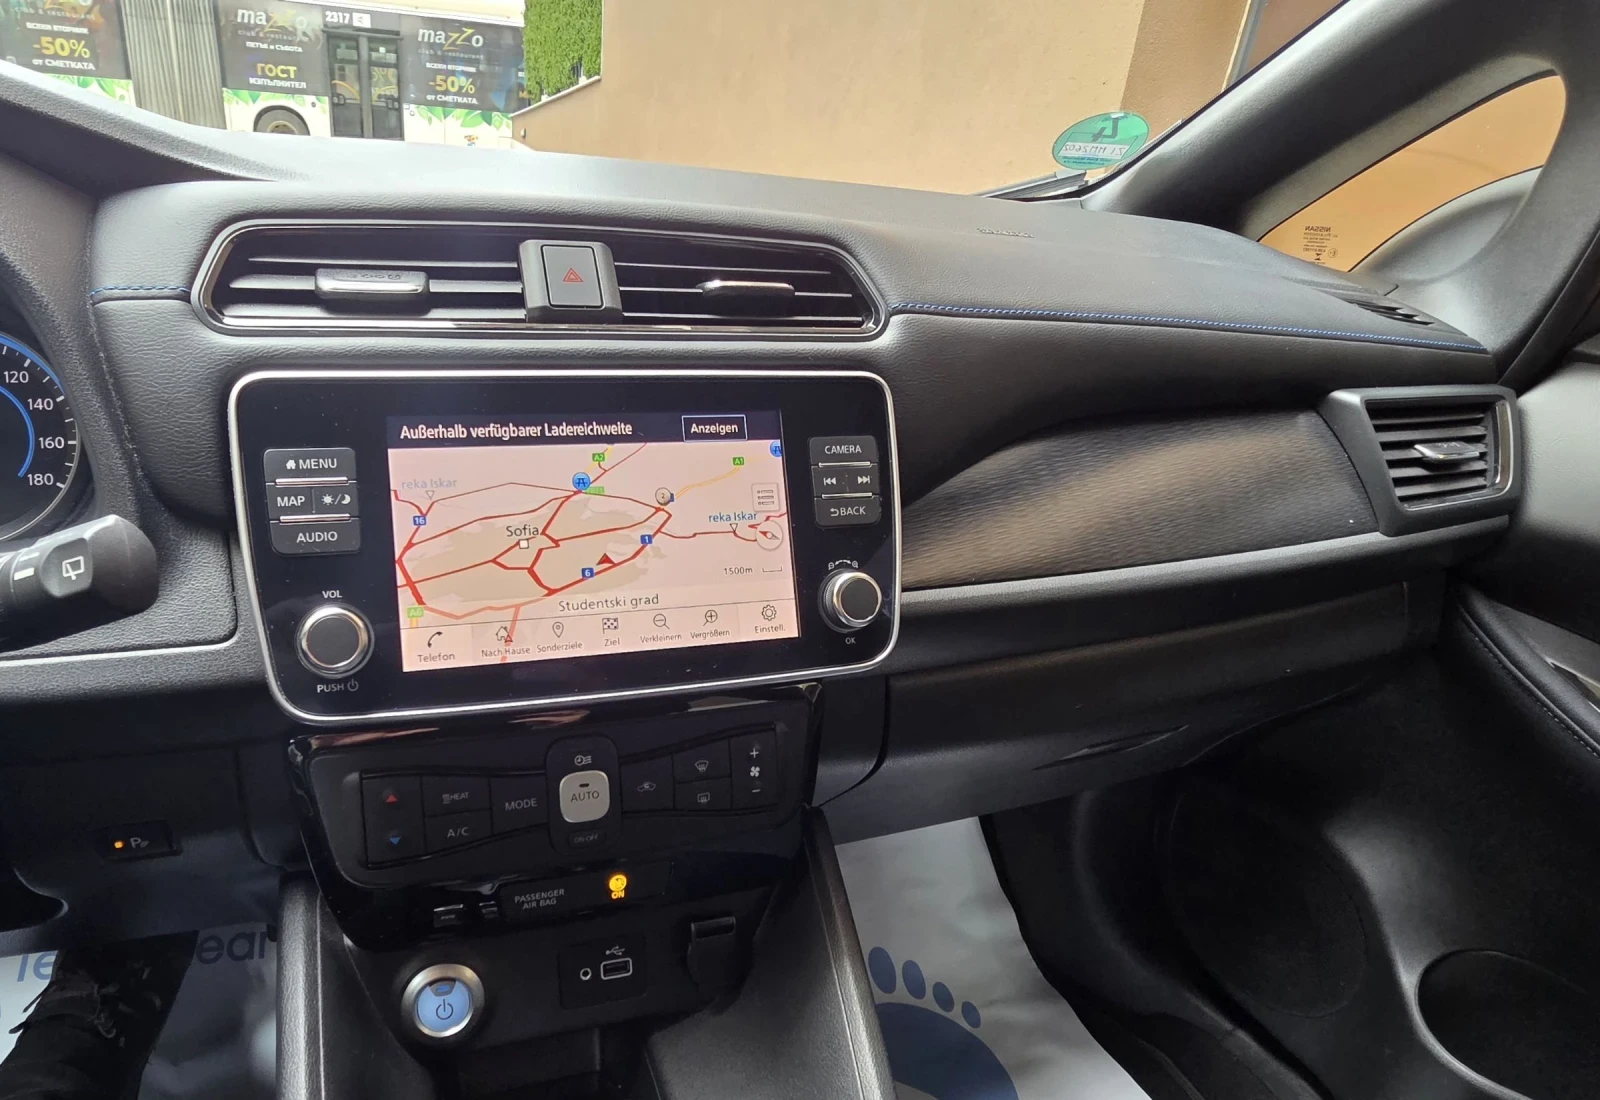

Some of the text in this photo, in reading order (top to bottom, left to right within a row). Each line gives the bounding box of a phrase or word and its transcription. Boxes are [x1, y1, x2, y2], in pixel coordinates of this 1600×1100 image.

[325, 11, 350, 23] 2317
[32, 36, 90, 58] -50%
[45, 59, 96, 70] СМЕТКАТА
[256, 63, 297, 79] ГОСТ
[249, 77, 306, 89] ИЗПЪЛНИТЕЛ
[428, 75, 476, 94] -50%
[437, 95, 479, 105] СМЕТКАТА
[4, 371, 29, 383] 120
[27, 398, 54, 411] 140
[400, 421, 633, 441] Außerhalb verfügbarer Ladereichweite
[690, 422, 739, 435] Anzeigen
[39, 437, 65, 449] 160
[824, 445, 862, 455] CAMERA
[299, 458, 337, 470] MENU
[27, 473, 54, 486] 180
[401, 479, 428, 489] reka
[276, 495, 305, 507] MAP
[708, 511, 758, 523] reka Iskar
[840, 506, 866, 516] BACK
[414, 517, 426, 526] 16
[296, 531, 338, 543] AUDIO
[506, 525, 539, 538] Sofia
[724, 567, 753, 576] 1500m
[322, 590, 342, 599] VOL
[559, 594, 659, 612] Studentski grad
[690, 629, 731, 640] Vergrößern
[754, 624, 786, 634] Einstell.
[604, 638, 620, 647] Ziel
[640, 633, 682, 644] Verkleinern
[845, 637, 856, 645] OK
[481, 646, 531, 658] Nach Hause
[537, 641, 583, 653] Sonderziele
[417, 652, 456, 663] Telefon
[316, 683, 345, 693] PUSH
[450, 792, 470, 801] HEAT
[570, 791, 599, 803] AUTO
[505, 798, 538, 811] MODE
[447, 827, 469, 838] A/C
[514, 888, 565, 904] PASSENGER
[611, 891, 624, 899] ON
[522, 898, 557, 910] AIR BAG
